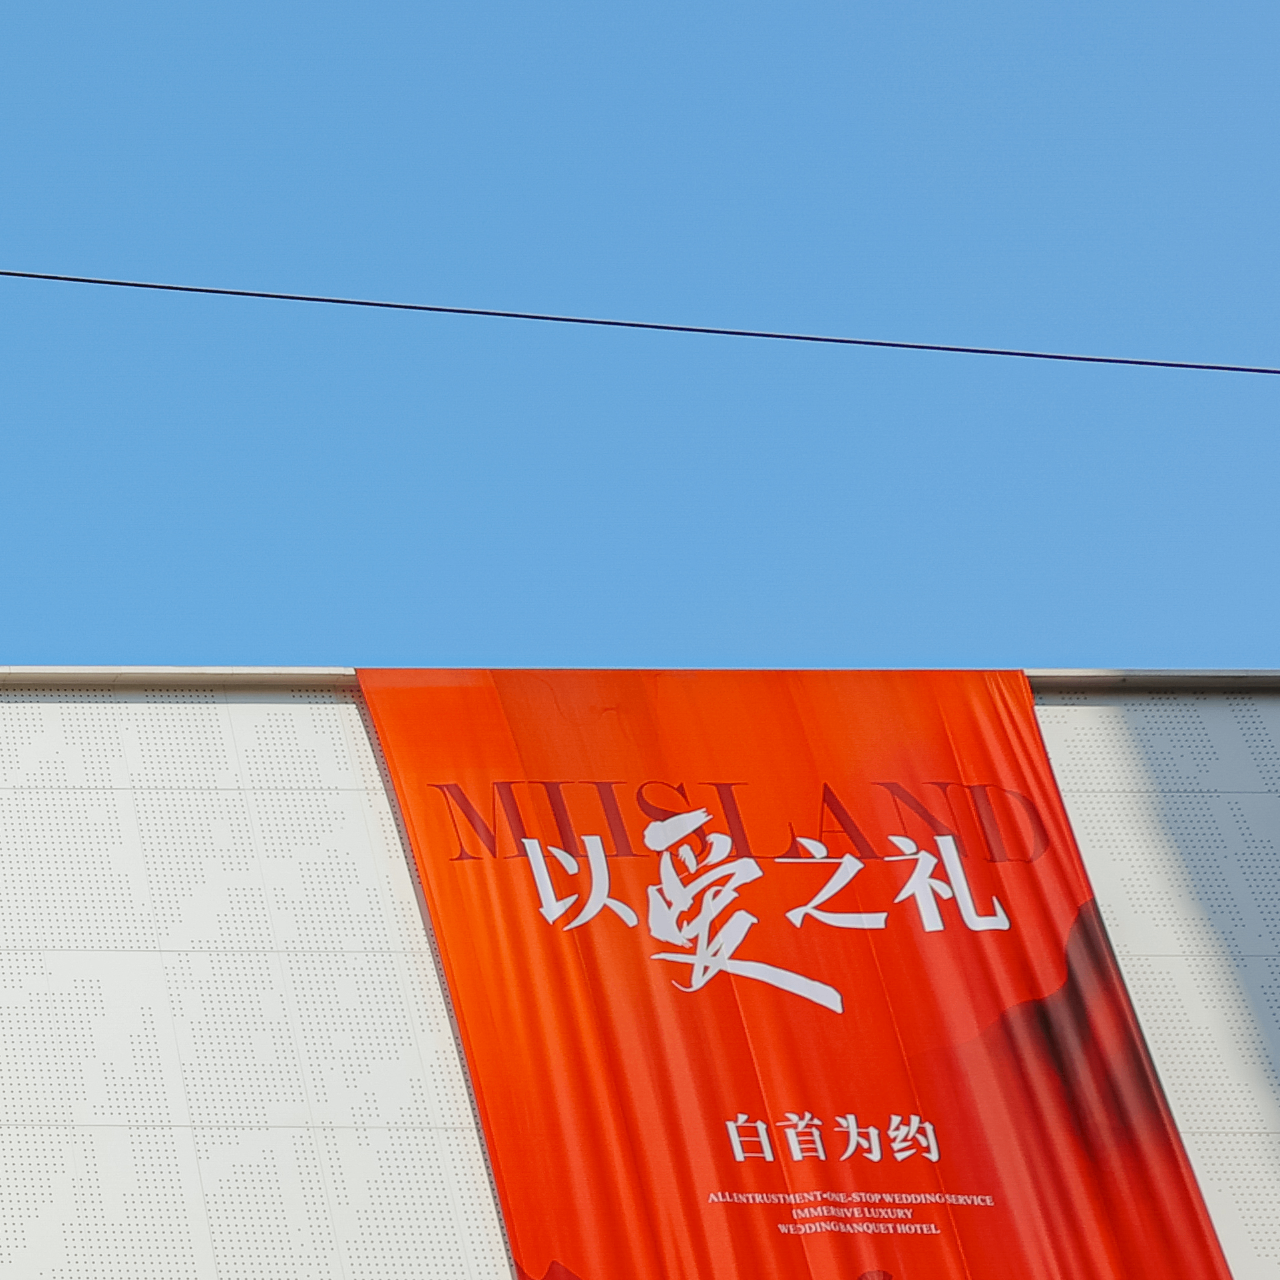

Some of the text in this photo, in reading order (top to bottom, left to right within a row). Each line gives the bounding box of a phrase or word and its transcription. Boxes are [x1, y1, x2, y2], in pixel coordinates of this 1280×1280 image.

[725, 1111, 940, 1162] 白首为约
[864, 1207, 913, 1219] LUXURY
[896, 1223, 941, 1234] HOTEL
